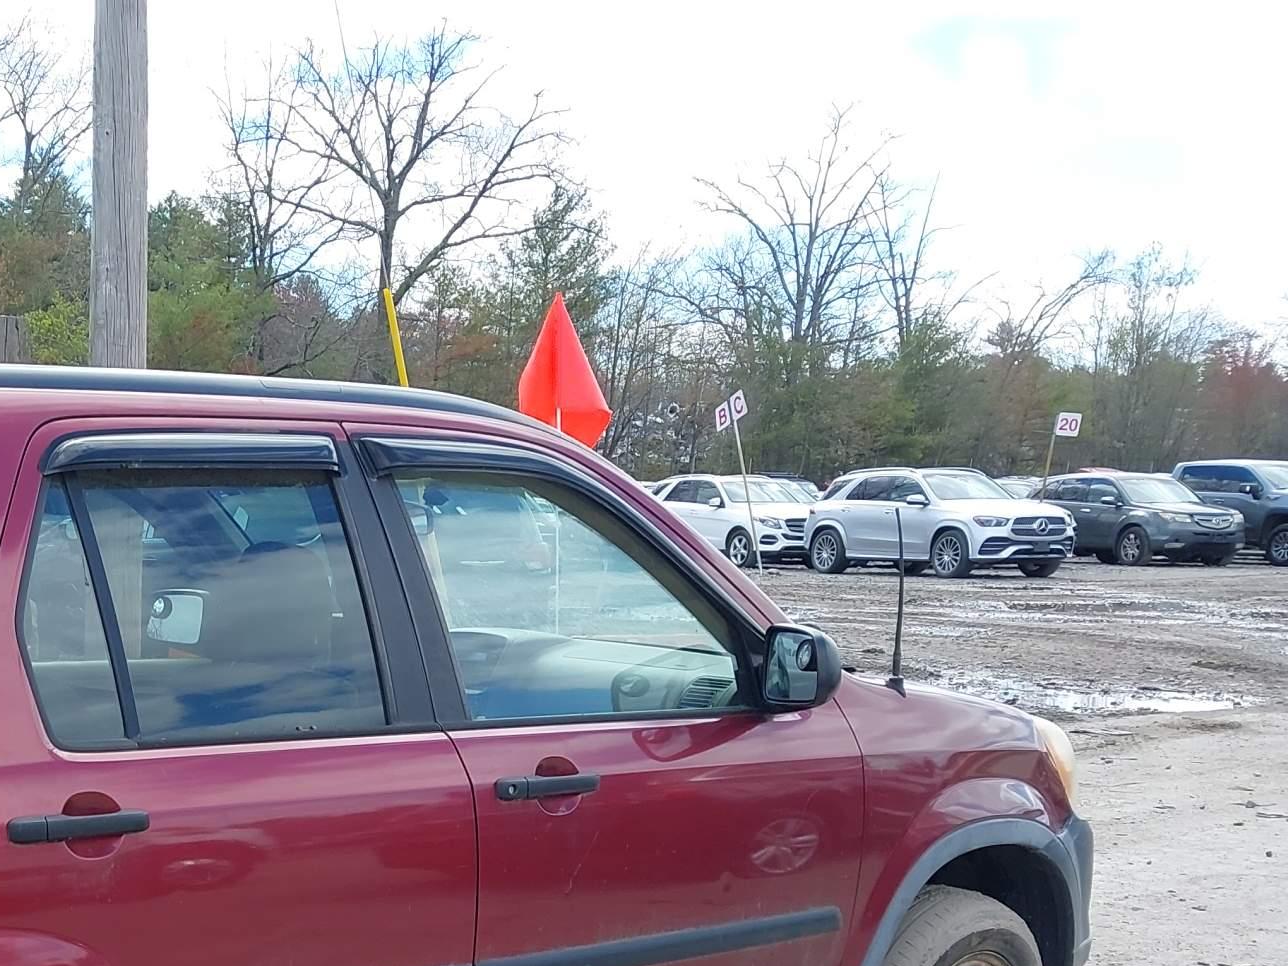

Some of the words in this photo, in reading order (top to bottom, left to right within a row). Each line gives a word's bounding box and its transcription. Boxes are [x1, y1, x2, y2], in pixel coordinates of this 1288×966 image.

[733, 396, 744, 414] C
[718, 407, 728, 427] B
[1058, 417, 1079, 432] 20
